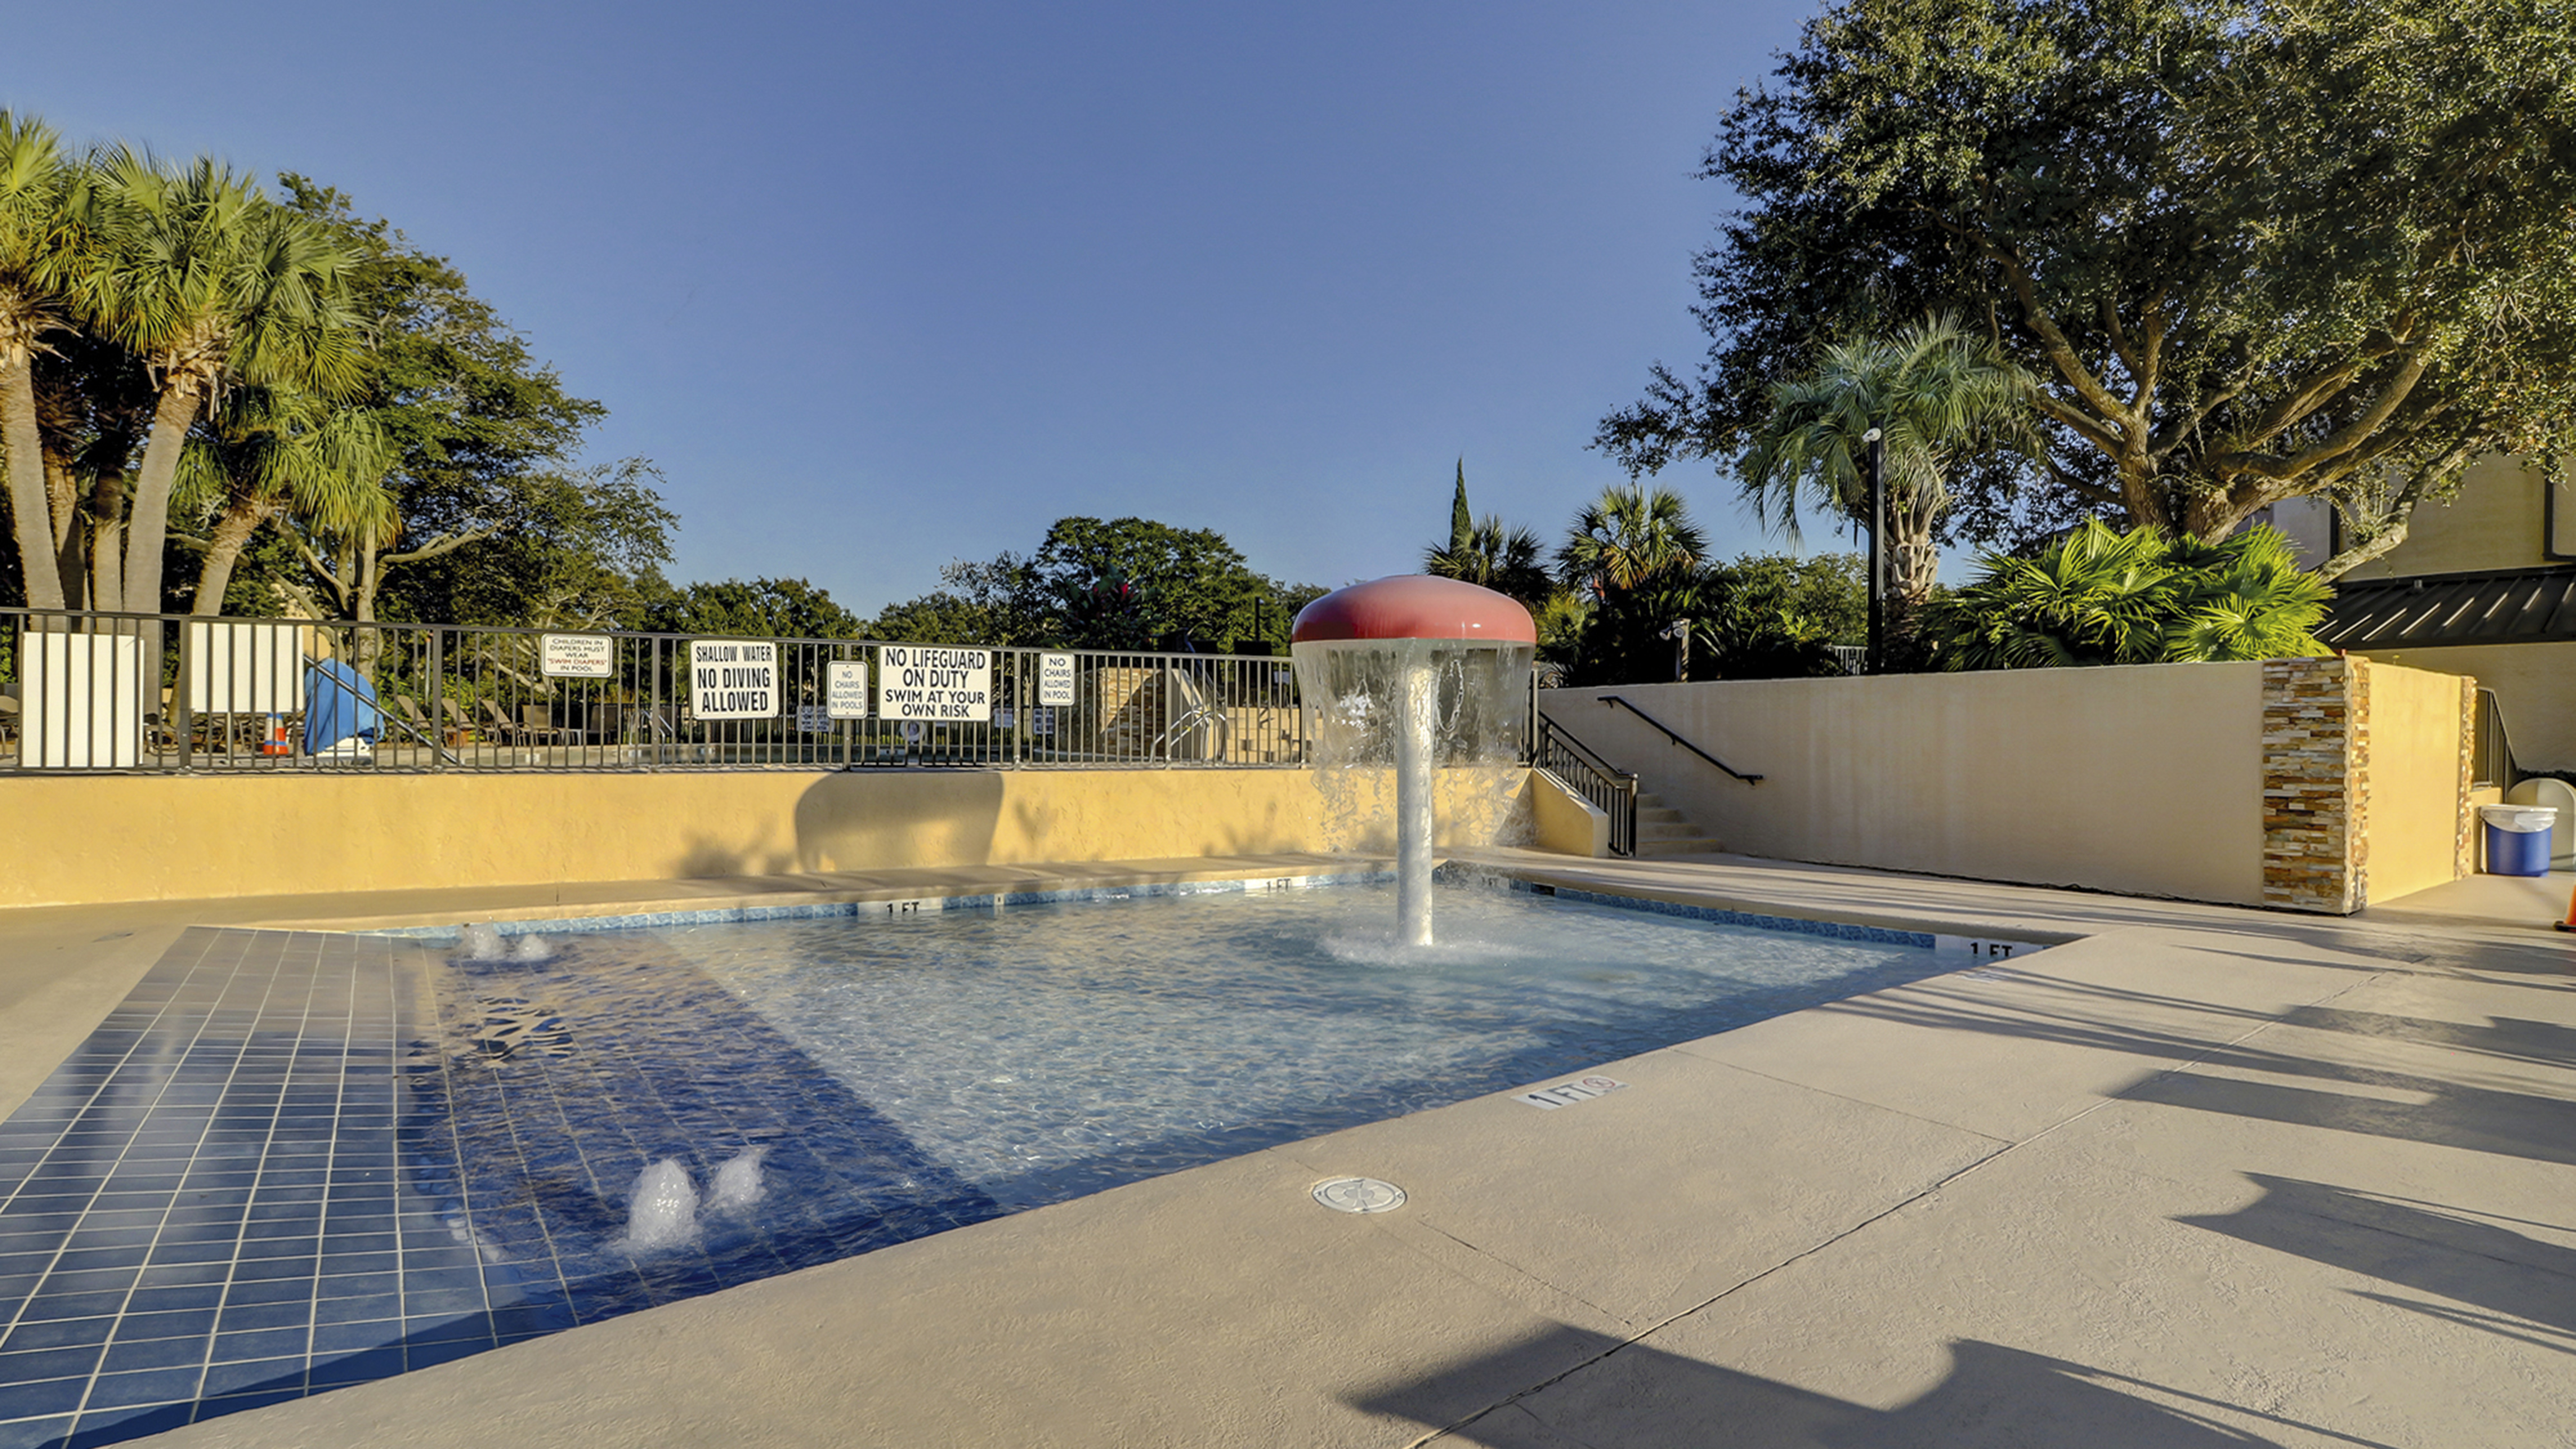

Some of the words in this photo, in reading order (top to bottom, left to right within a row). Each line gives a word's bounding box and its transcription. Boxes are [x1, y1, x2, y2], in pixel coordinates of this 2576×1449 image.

[696, 646, 737, 662] SHALLOW
[742, 646, 772, 661] WATER
[886, 648, 906, 667] NO
[913, 649, 986, 669] LIFEGUARD
[1049, 658, 1066, 667] NO
[698, 668, 716, 689] NO
[723, 667, 770, 688] DIVING
[842, 671, 852, 679] NO
[903, 669, 924, 687] ON
[930, 669, 969, 688] DUTY
[1044, 668, 1071, 677] CHAIRS
[1044, 680, 1071, 688] ALLOWED
[832, 691, 863, 699] ALLOWED
[885, 689, 922, 703] SWIM
[927, 690, 944, 703] AT
[949, 691, 985, 704] YOUR
[1044, 690, 1051, 699] IN
[1053, 690, 1070, 699] POOL
[702, 691, 768, 712] ALLOWED
[841, 701, 862, 709] POOLS
[902, 703, 935, 717] OWN
[941, 705, 969, 717] RISK
[1266, 881, 1271, 891] 1
[1277, 878, 1291, 891] FT
[887, 903, 893, 914] 1
[902, 902, 919, 913] FT
[1970, 942, 1978, 954] 1
[1990, 944, 2012, 956] FT
[1528, 1094, 1562, 1105] 1
[1548, 1083, 1596, 1101] FT
